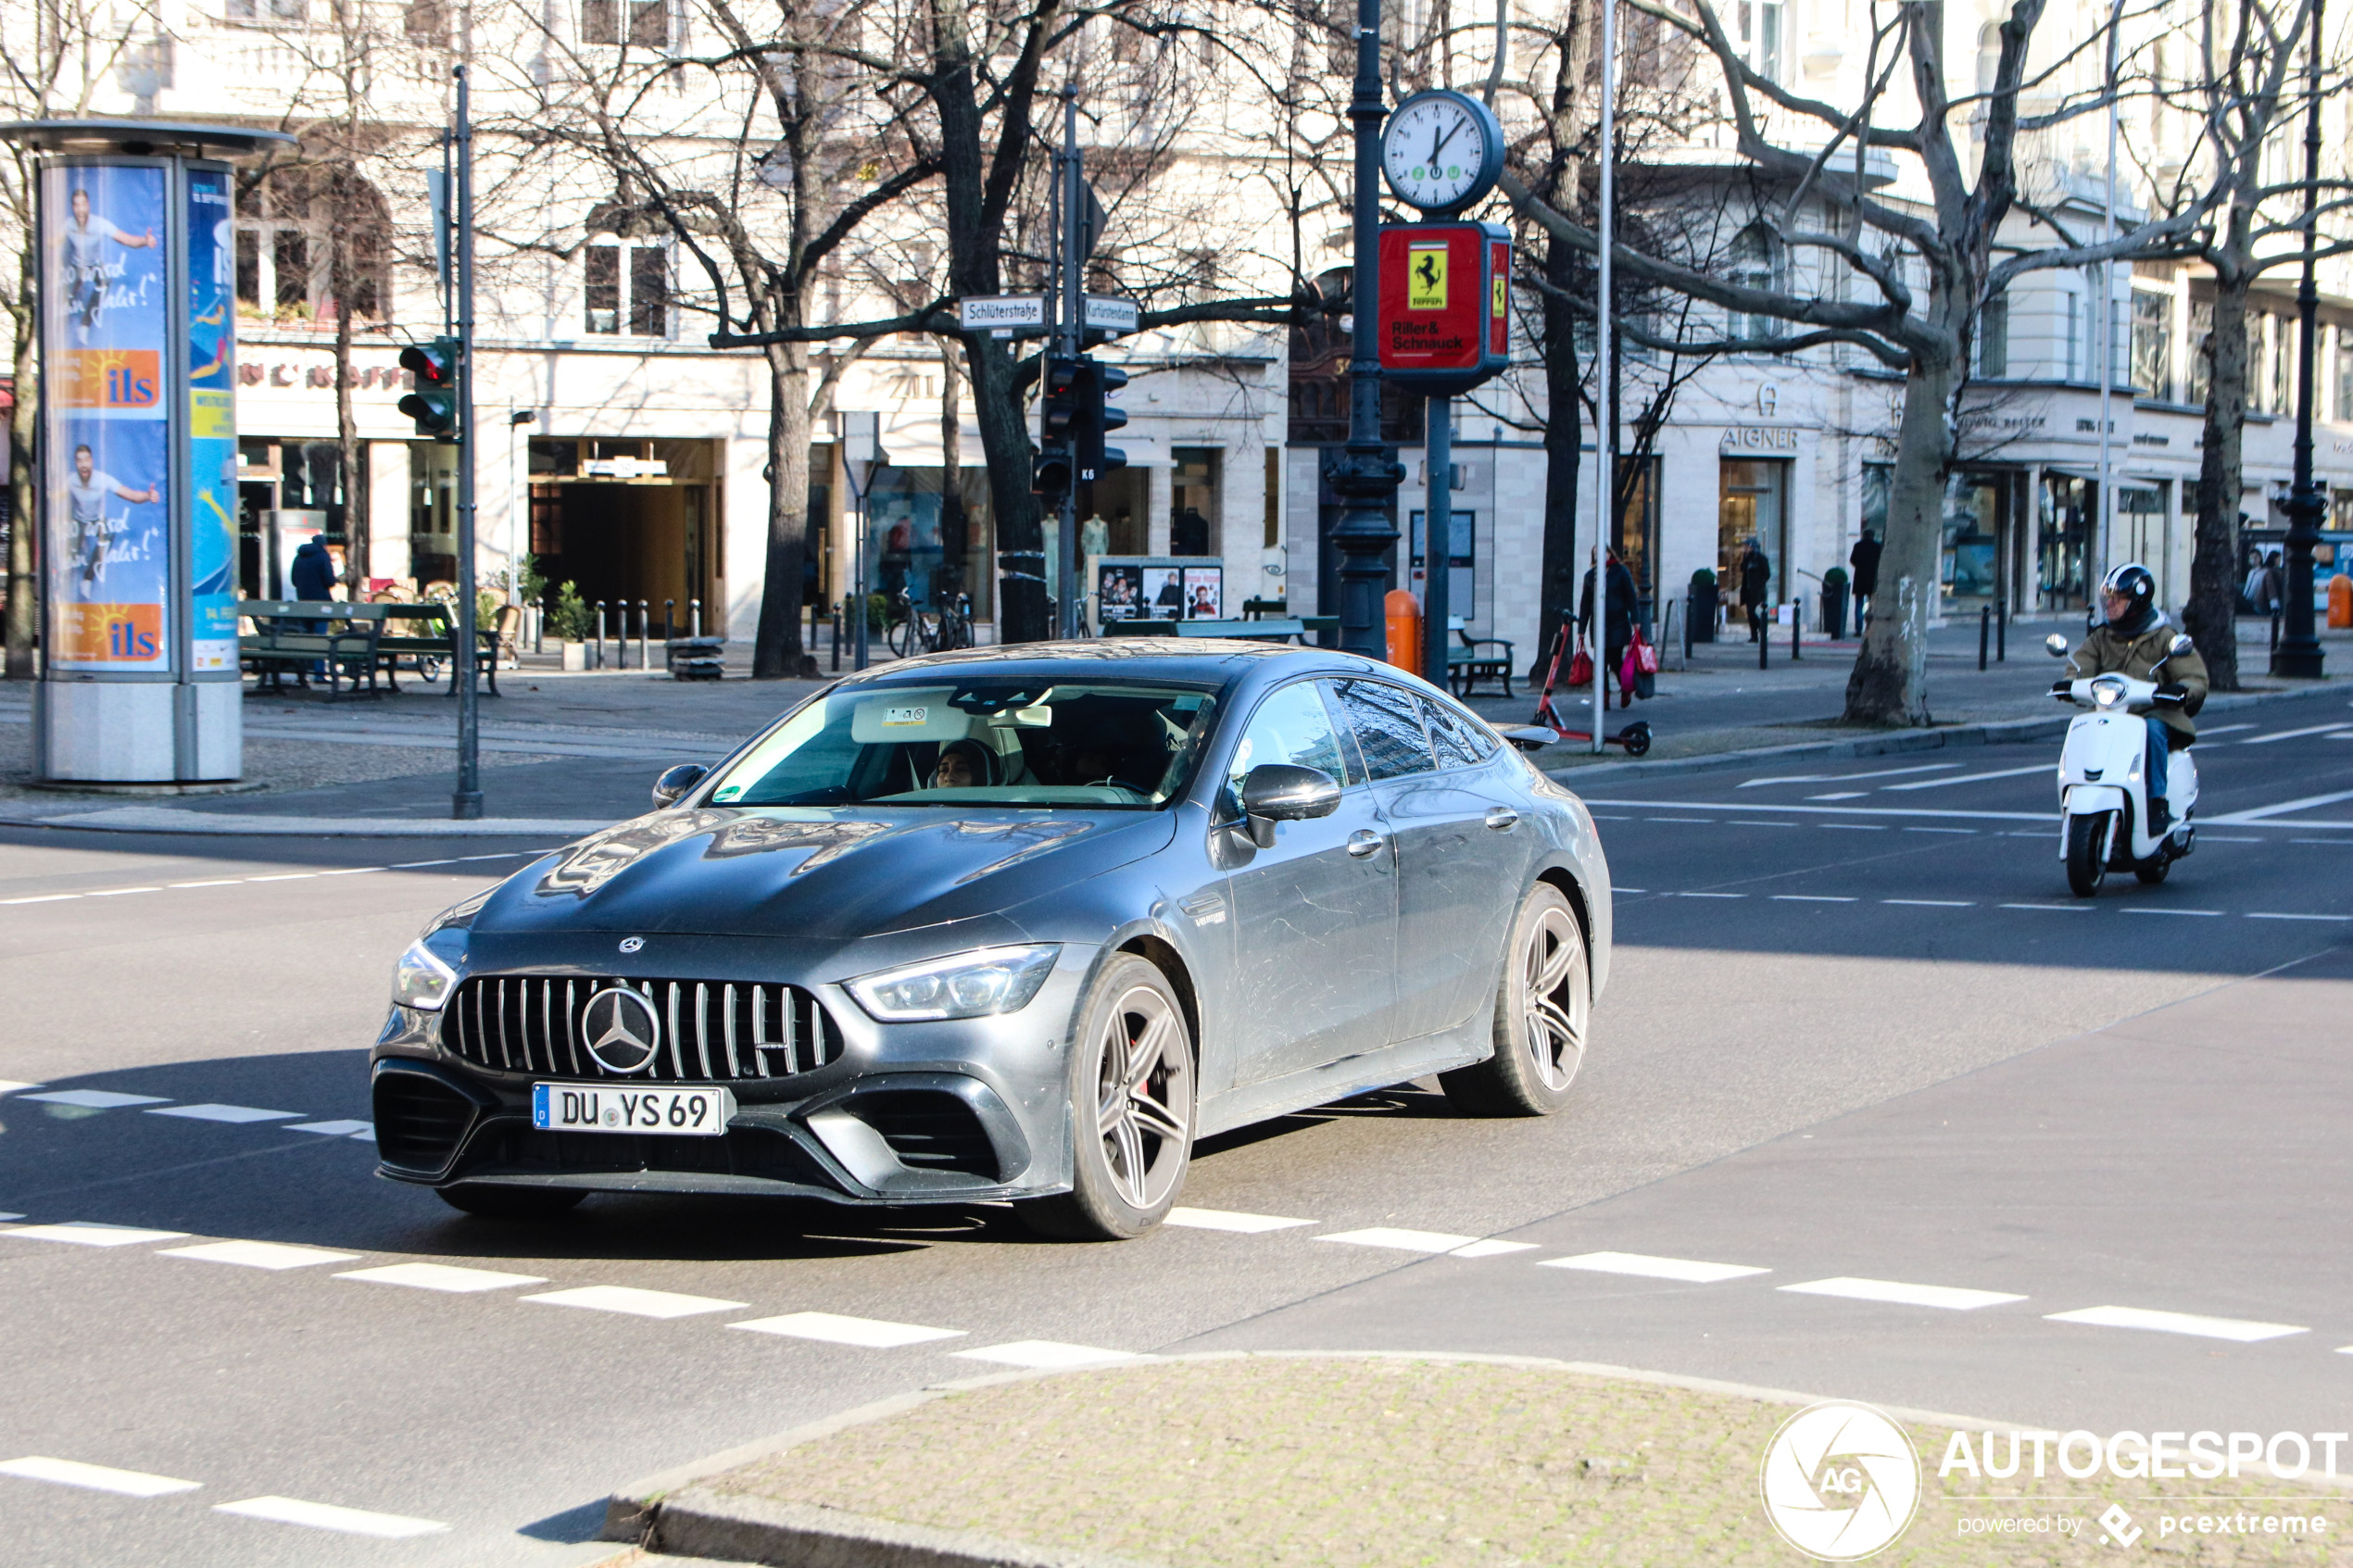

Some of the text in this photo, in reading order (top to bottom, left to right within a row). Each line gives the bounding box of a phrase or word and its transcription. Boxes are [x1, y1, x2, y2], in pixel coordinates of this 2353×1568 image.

[1413, 297, 1442, 306] Ferrari
[969, 302, 1038, 320] Schlüterstraße
[1087, 301, 1134, 321] Kurfürstendamm
[1392, 320, 1439, 334] Riller &
[1392, 334, 1463, 349] Schnauck
[108, 368, 154, 404] ils
[1719, 427, 1797, 448] AIGNER
[1081, 469, 1095, 480] K6
[110, 621, 156, 658] ils
[538, 1110, 546, 1121] D
[562, 1092, 708, 1127] DU YS 69
